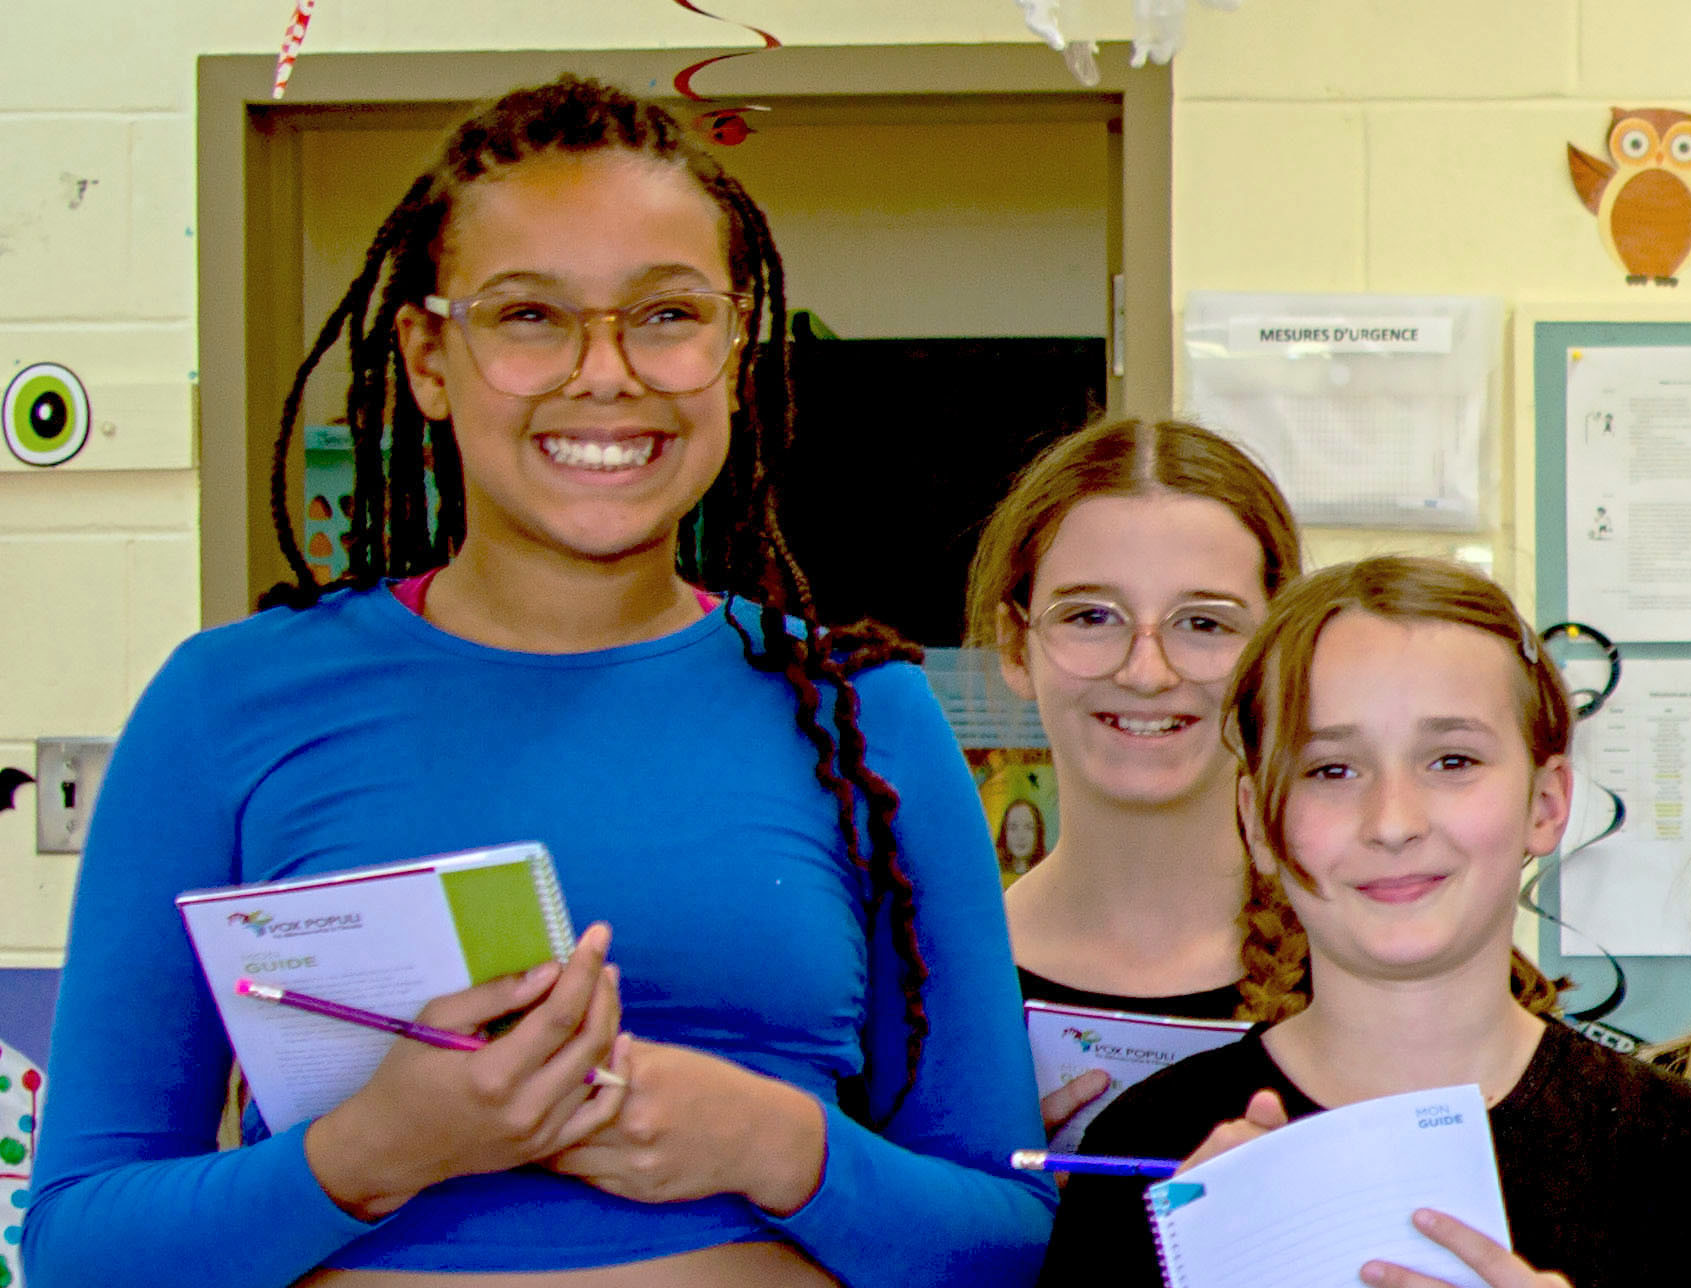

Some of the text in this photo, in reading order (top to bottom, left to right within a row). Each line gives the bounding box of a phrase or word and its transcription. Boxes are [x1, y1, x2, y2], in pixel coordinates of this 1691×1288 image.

[1259, 328, 1419, 342] MESURES D'URGENCE
[1418, 1112, 1465, 1129] GUIDE
